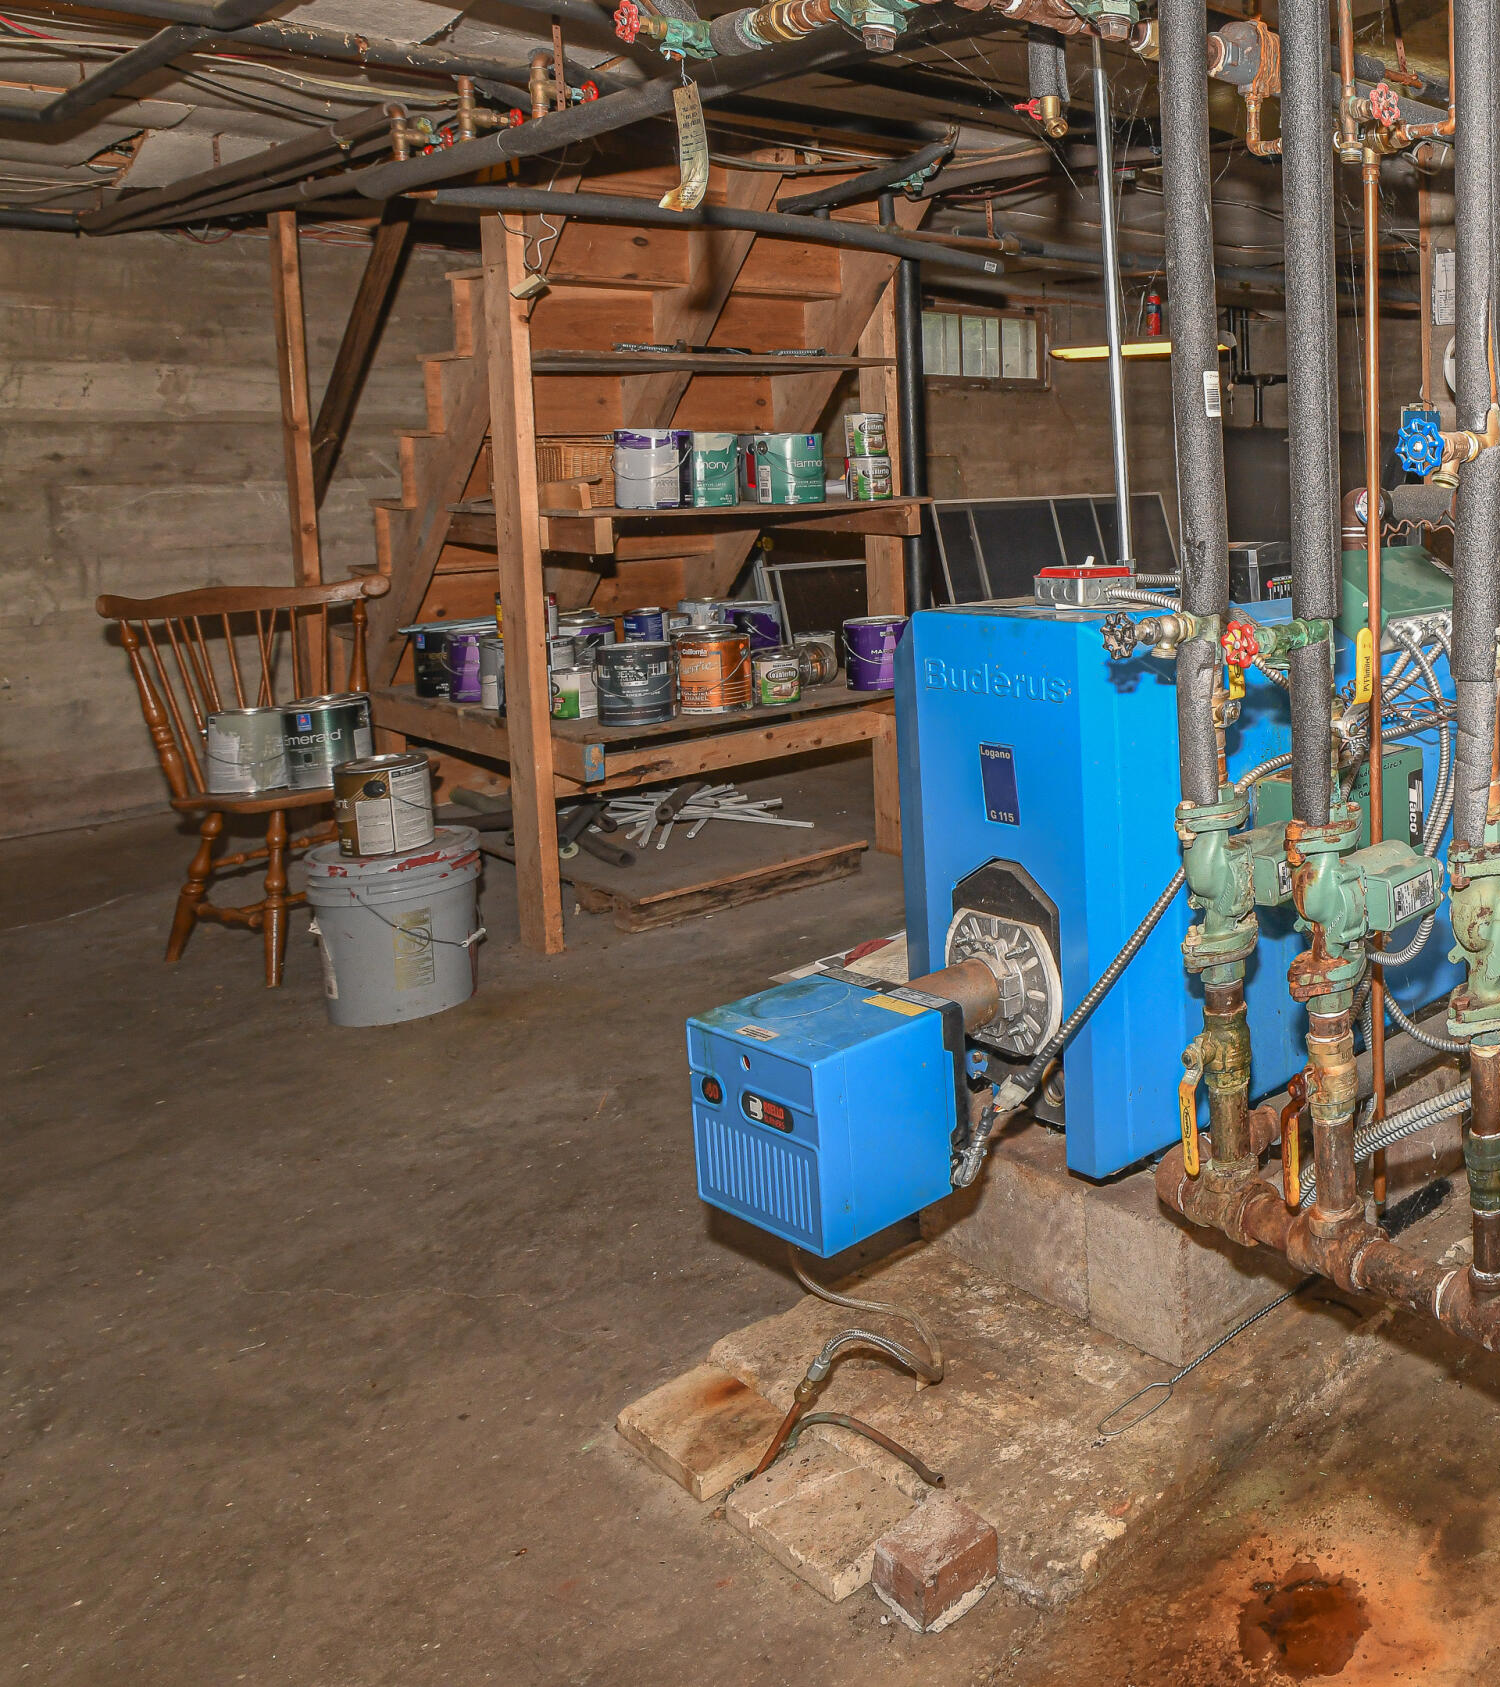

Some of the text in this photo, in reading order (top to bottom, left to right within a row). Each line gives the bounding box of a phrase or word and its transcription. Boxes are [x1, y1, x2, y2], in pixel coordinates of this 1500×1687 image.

[925, 657, 1072, 703] Buderus
[284, 728, 342, 746] Emerald
[980, 745, 1011, 759] Logano
[990, 809, 1015, 822] G 115
